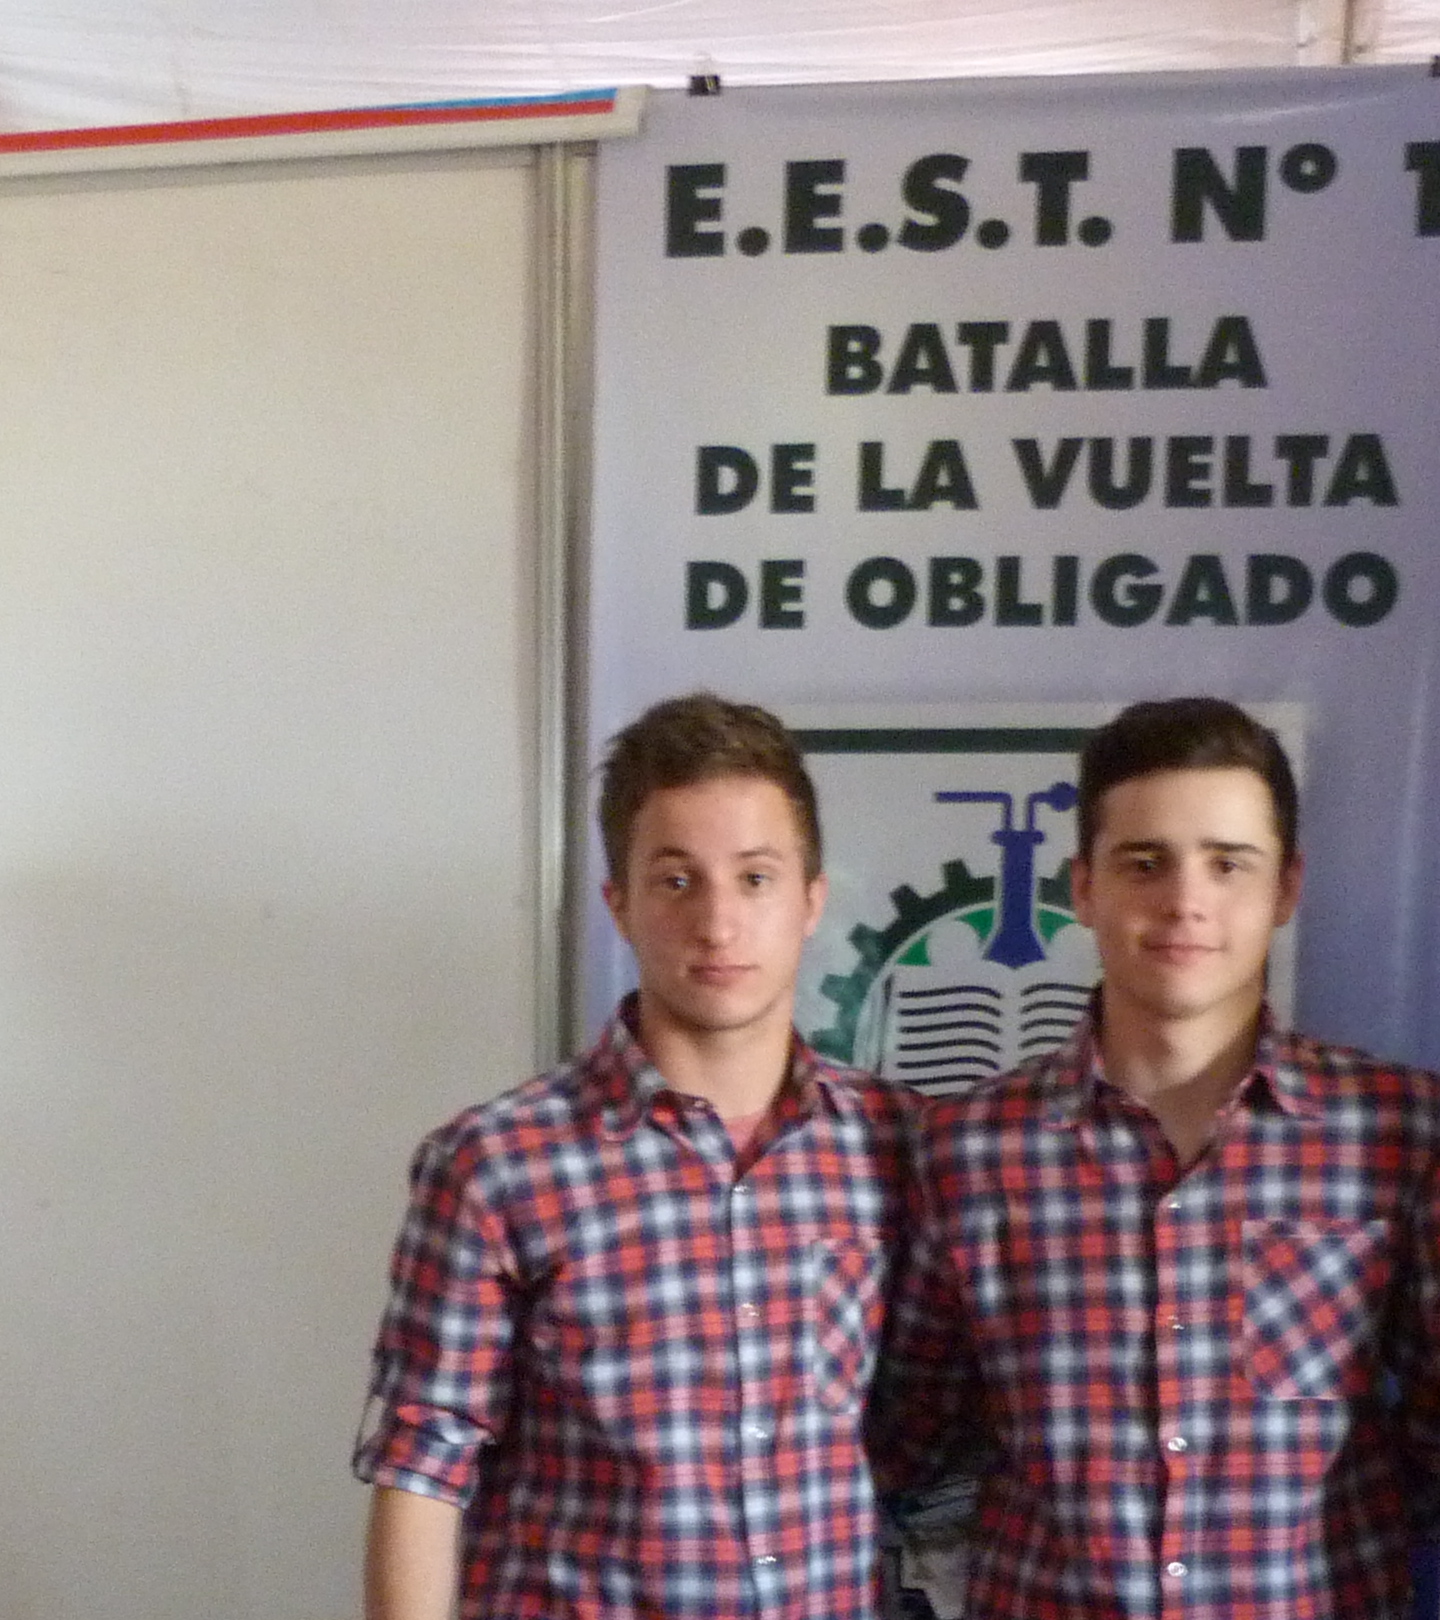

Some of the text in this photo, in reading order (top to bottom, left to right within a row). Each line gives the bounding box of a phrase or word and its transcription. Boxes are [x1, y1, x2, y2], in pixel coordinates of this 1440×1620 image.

[665, 150, 1113, 258] E.E.S.T.
[826, 315, 1269, 395] BATALLA
[696, 432, 1401, 515] DE LA VUELTA
[685, 550, 1402, 631] DE OBLIGADO
